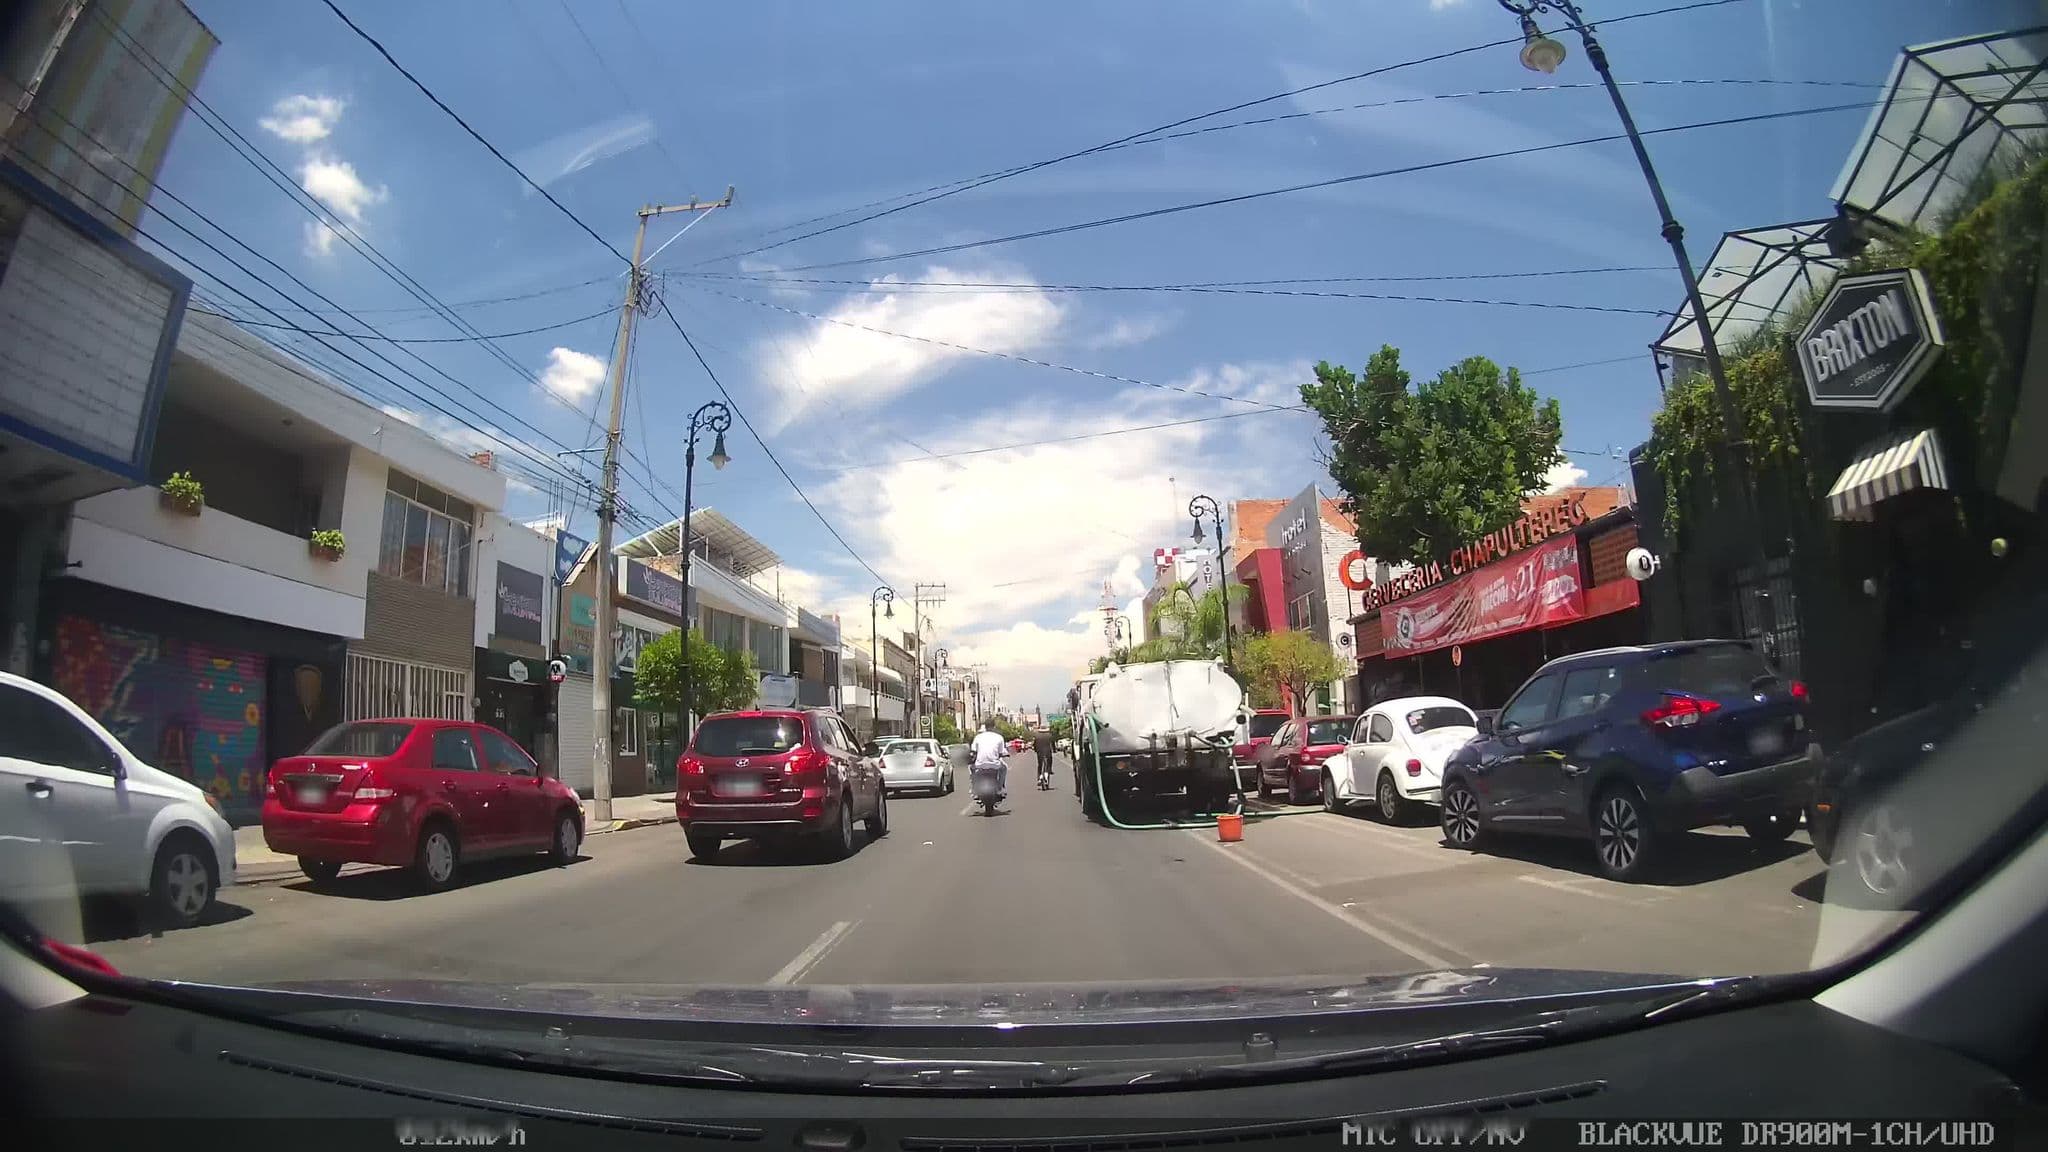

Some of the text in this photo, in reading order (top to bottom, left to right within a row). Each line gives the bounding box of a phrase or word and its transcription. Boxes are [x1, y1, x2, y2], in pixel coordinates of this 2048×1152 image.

[1806, 289, 1908, 383] BRIXTON
[1281, 507, 1307, 545] hotel
[1362, 491, 1587, 611] CERVECERIA CHAPULTEPEC
